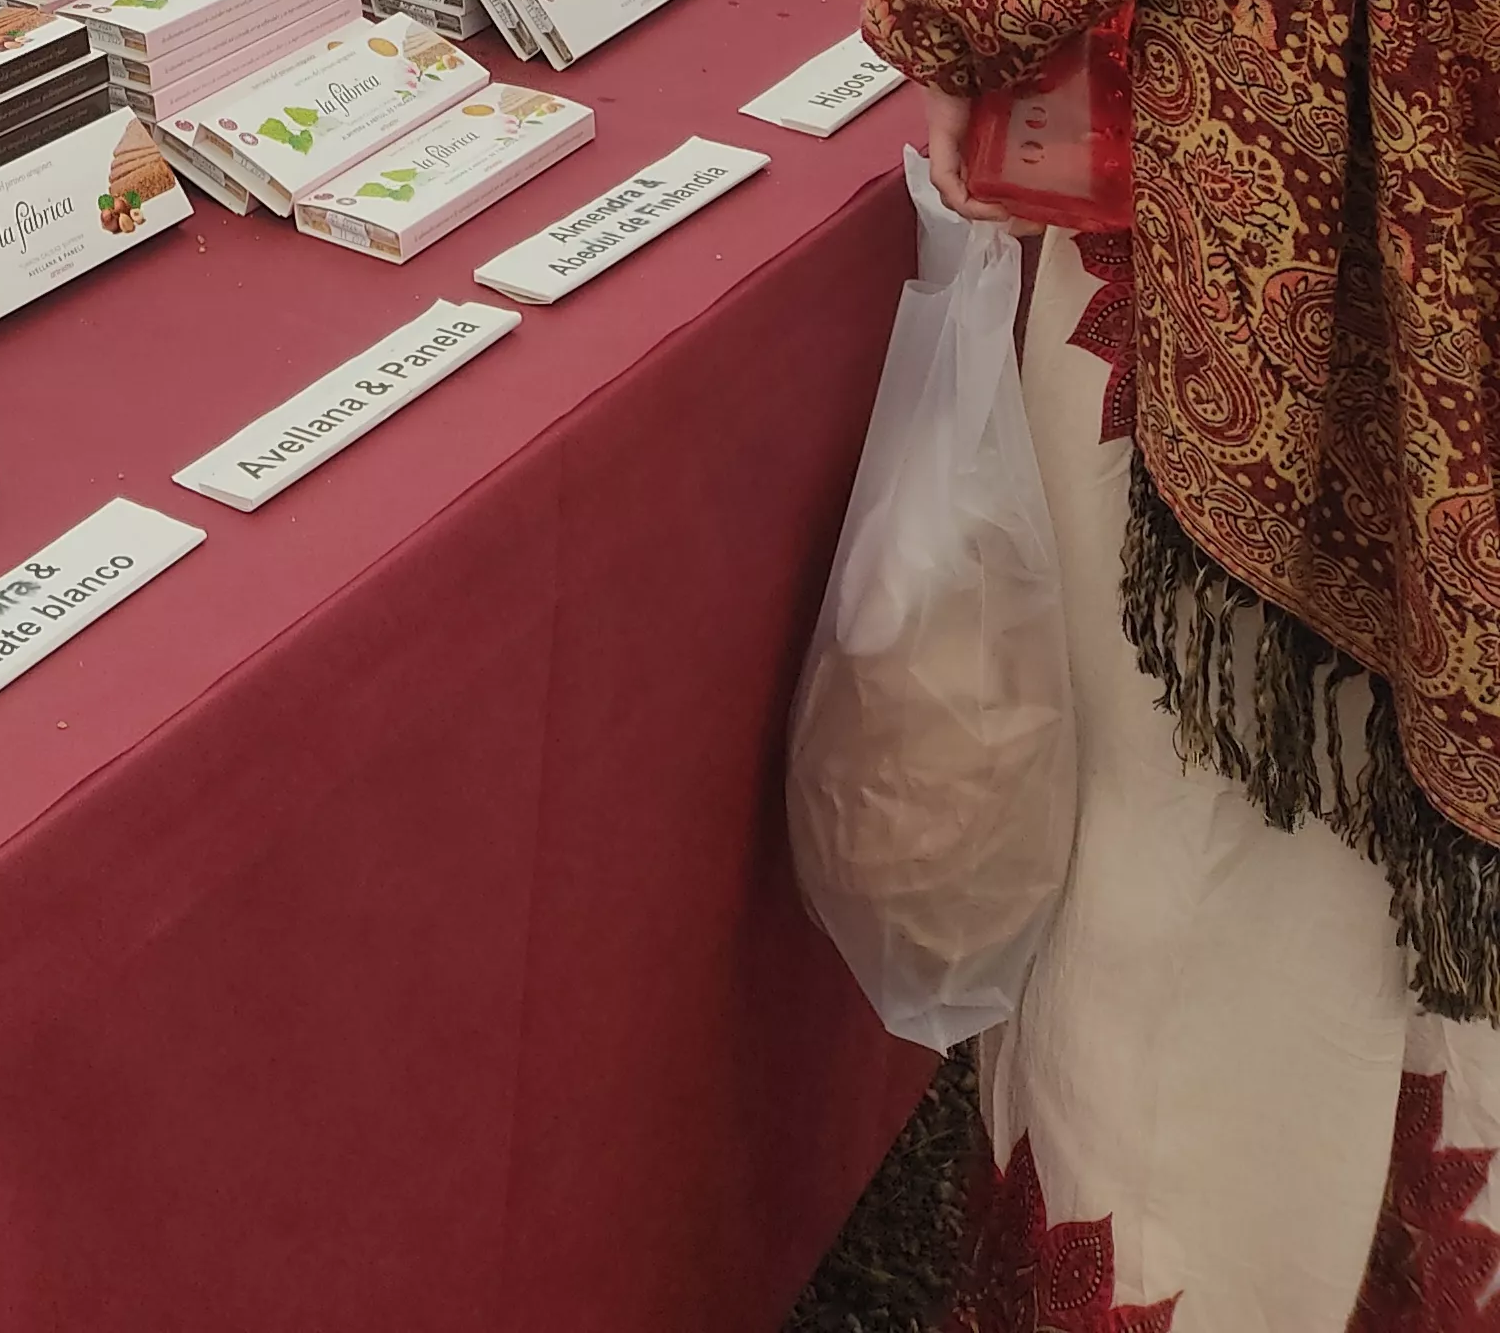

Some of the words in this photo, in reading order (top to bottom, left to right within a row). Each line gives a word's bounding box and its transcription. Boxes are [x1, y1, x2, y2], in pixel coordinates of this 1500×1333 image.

[315, 97, 336, 116] la
[808, 73, 875, 109] Higos
[860, 62, 889, 73] &
[548, 232, 625, 276] Abedul
[620, 216, 650, 234] de
[635, 165, 729, 218] Finlandia
[549, 187, 643, 245] Almendra
[634, 178, 667, 189] &
[28, 258, 57, 277] AVELLANA
[63, 244, 85, 259] PANELA
[237, 397, 369, 480] Avellana
[354, 379, 394, 396] &
[377, 320, 481, 379] Panela
[24, 562, 61, 580] &
[31, 555, 135, 621] blanco
